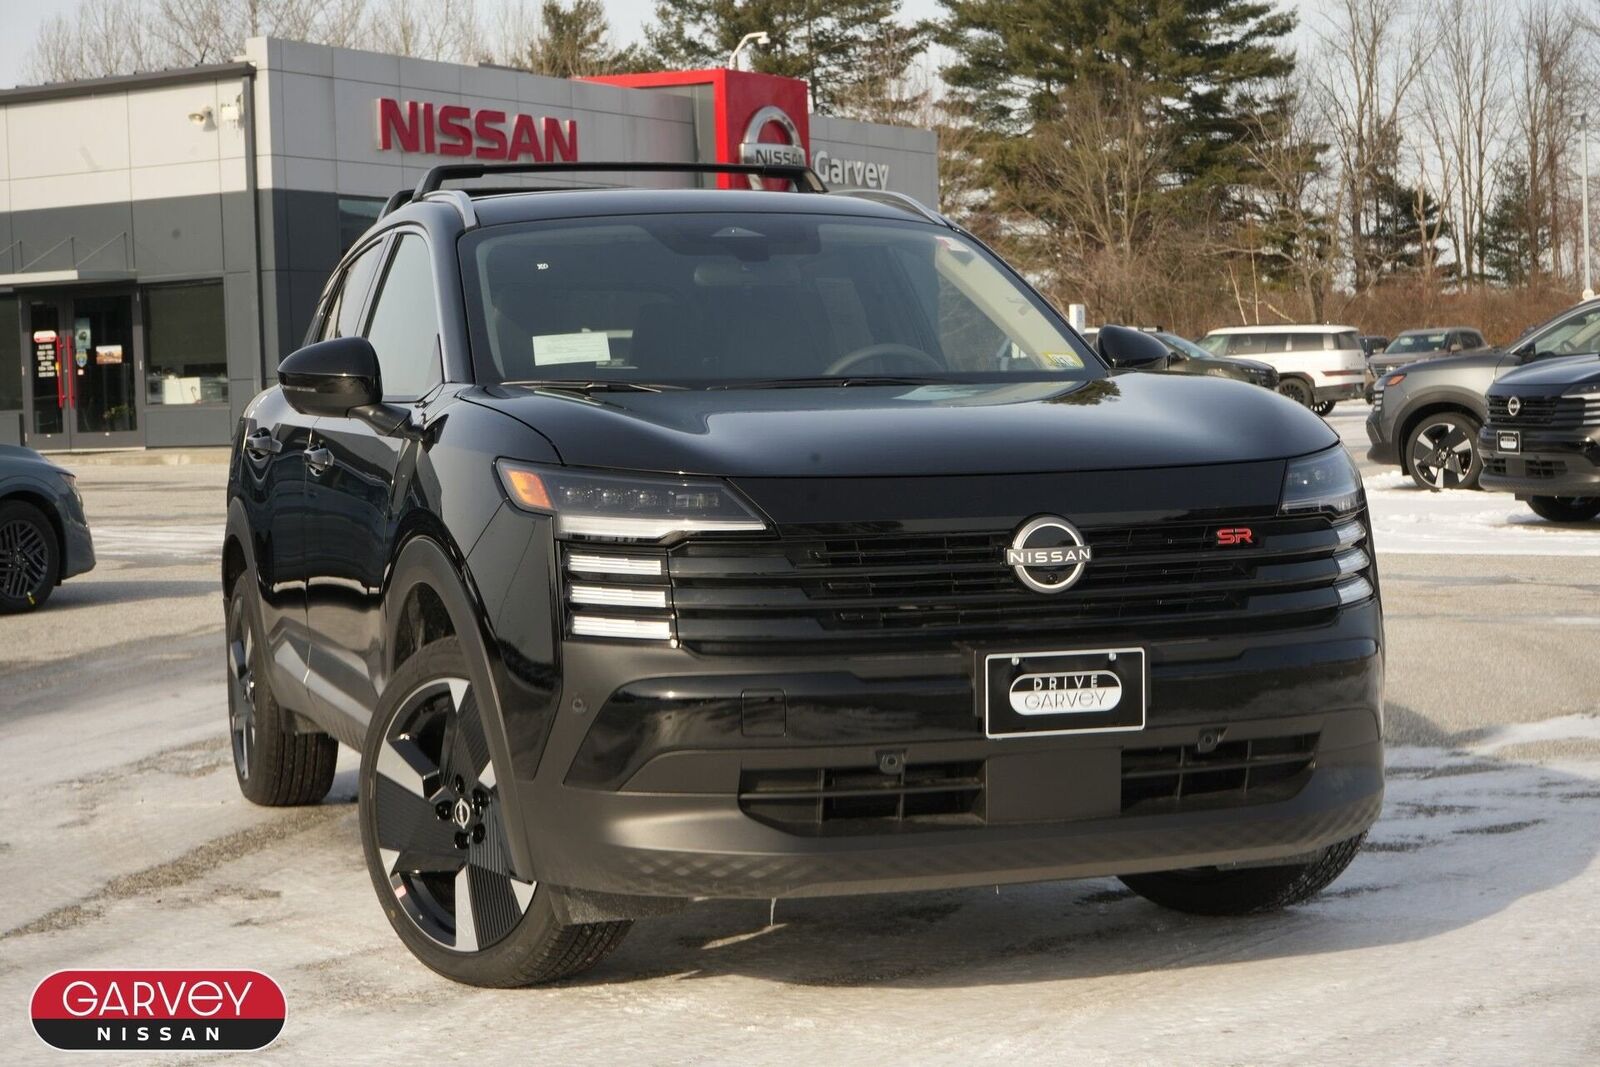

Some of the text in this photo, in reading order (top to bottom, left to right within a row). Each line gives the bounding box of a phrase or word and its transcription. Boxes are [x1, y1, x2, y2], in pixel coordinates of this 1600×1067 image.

[377, 98, 578, 162] NISSAN
[755, 149, 804, 167] NISSAN
[814, 150, 889, 191] Garvey
[1216, 527, 1253, 545] SR
[1009, 548, 1091, 564] NISSAN
[1033, 674, 1098, 691] DRIVE
[1024, 689, 1106, 710] GARVEY
